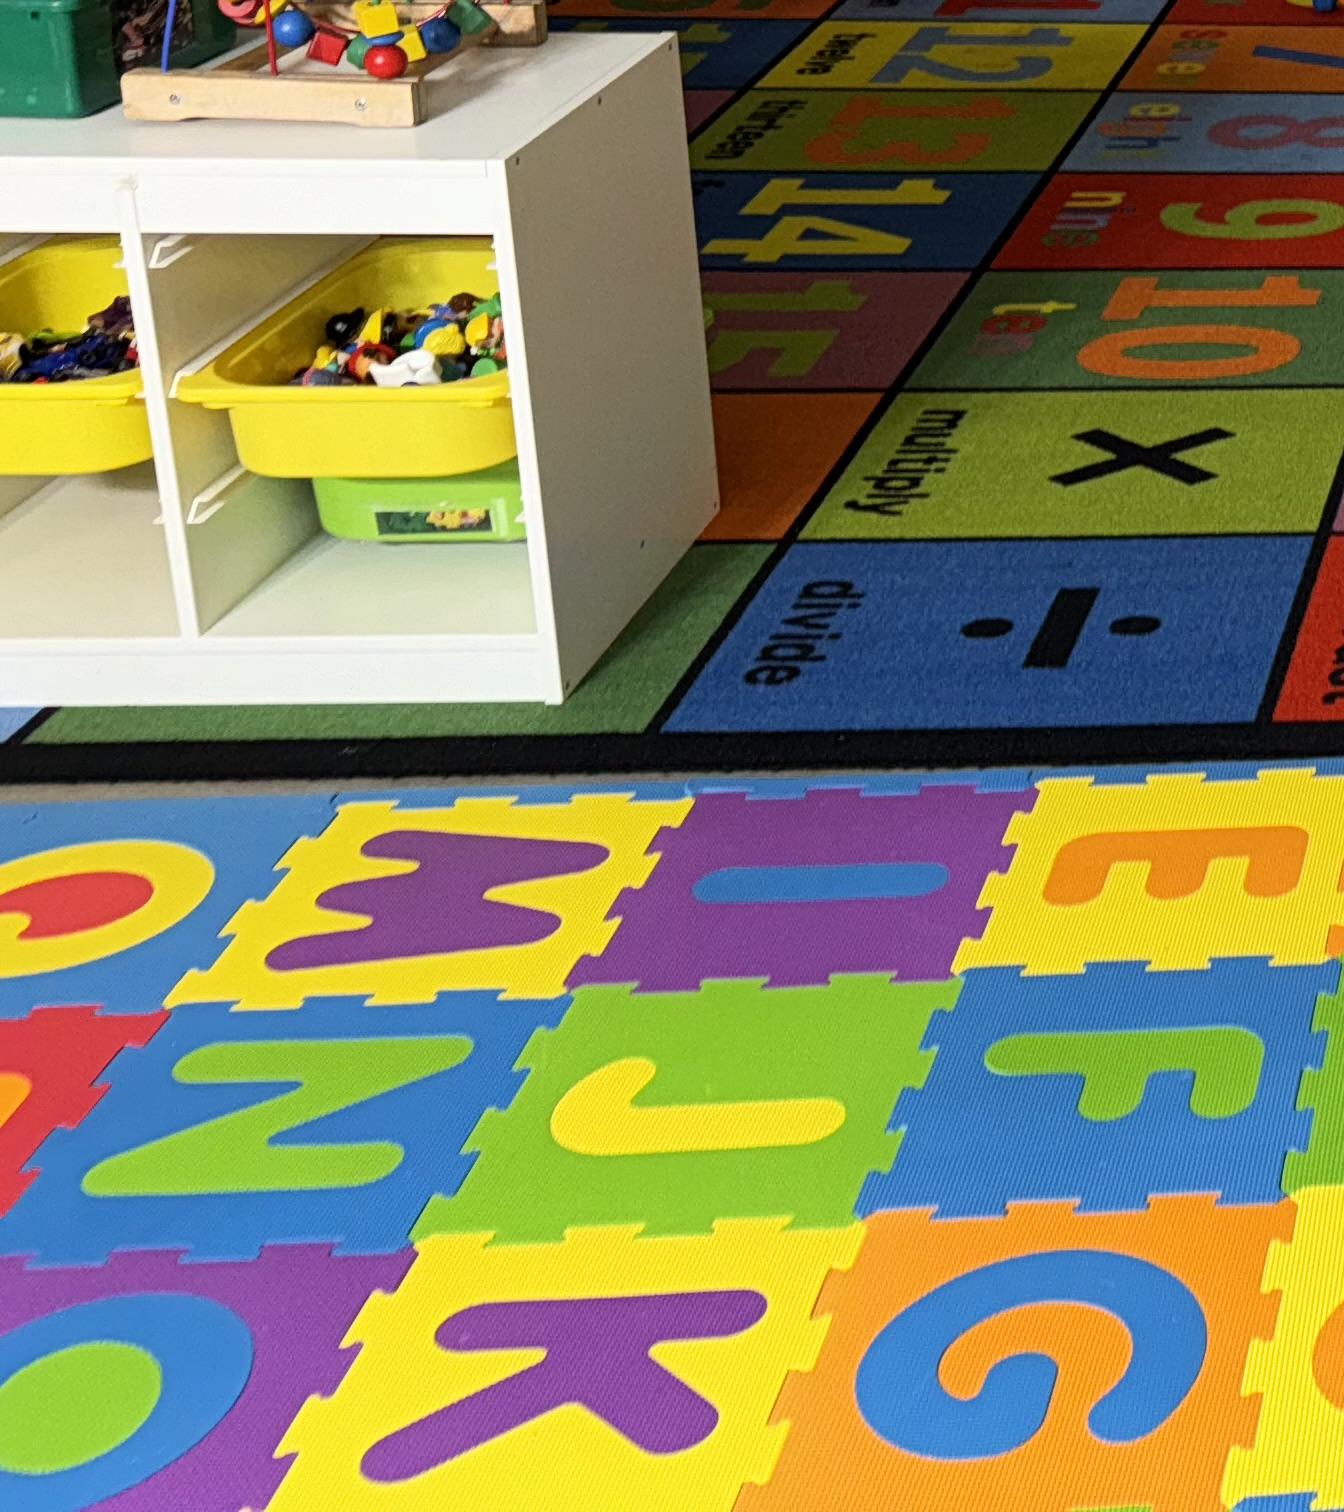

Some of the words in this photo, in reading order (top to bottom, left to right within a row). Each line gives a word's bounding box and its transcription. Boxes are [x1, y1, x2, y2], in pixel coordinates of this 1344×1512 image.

[867, 26, 1075, 84] 12
[804, 95, 1017, 165] 13
[700, 178, 953, 263] 14
[1076, 274, 1322, 380] 10
[844, 410, 968, 517] multiply
[743, 580, 865, 686] divide
[263, 827, 612, 973] M
[1041, 824, 1310, 907] E
[81, 1033, 475, 1199] N
[549, 1055, 847, 1157] J
[984, 1025, 1266, 1123] F
[358, 1289, 769, 1485] K
[853, 1247, 1208, 1463] G
